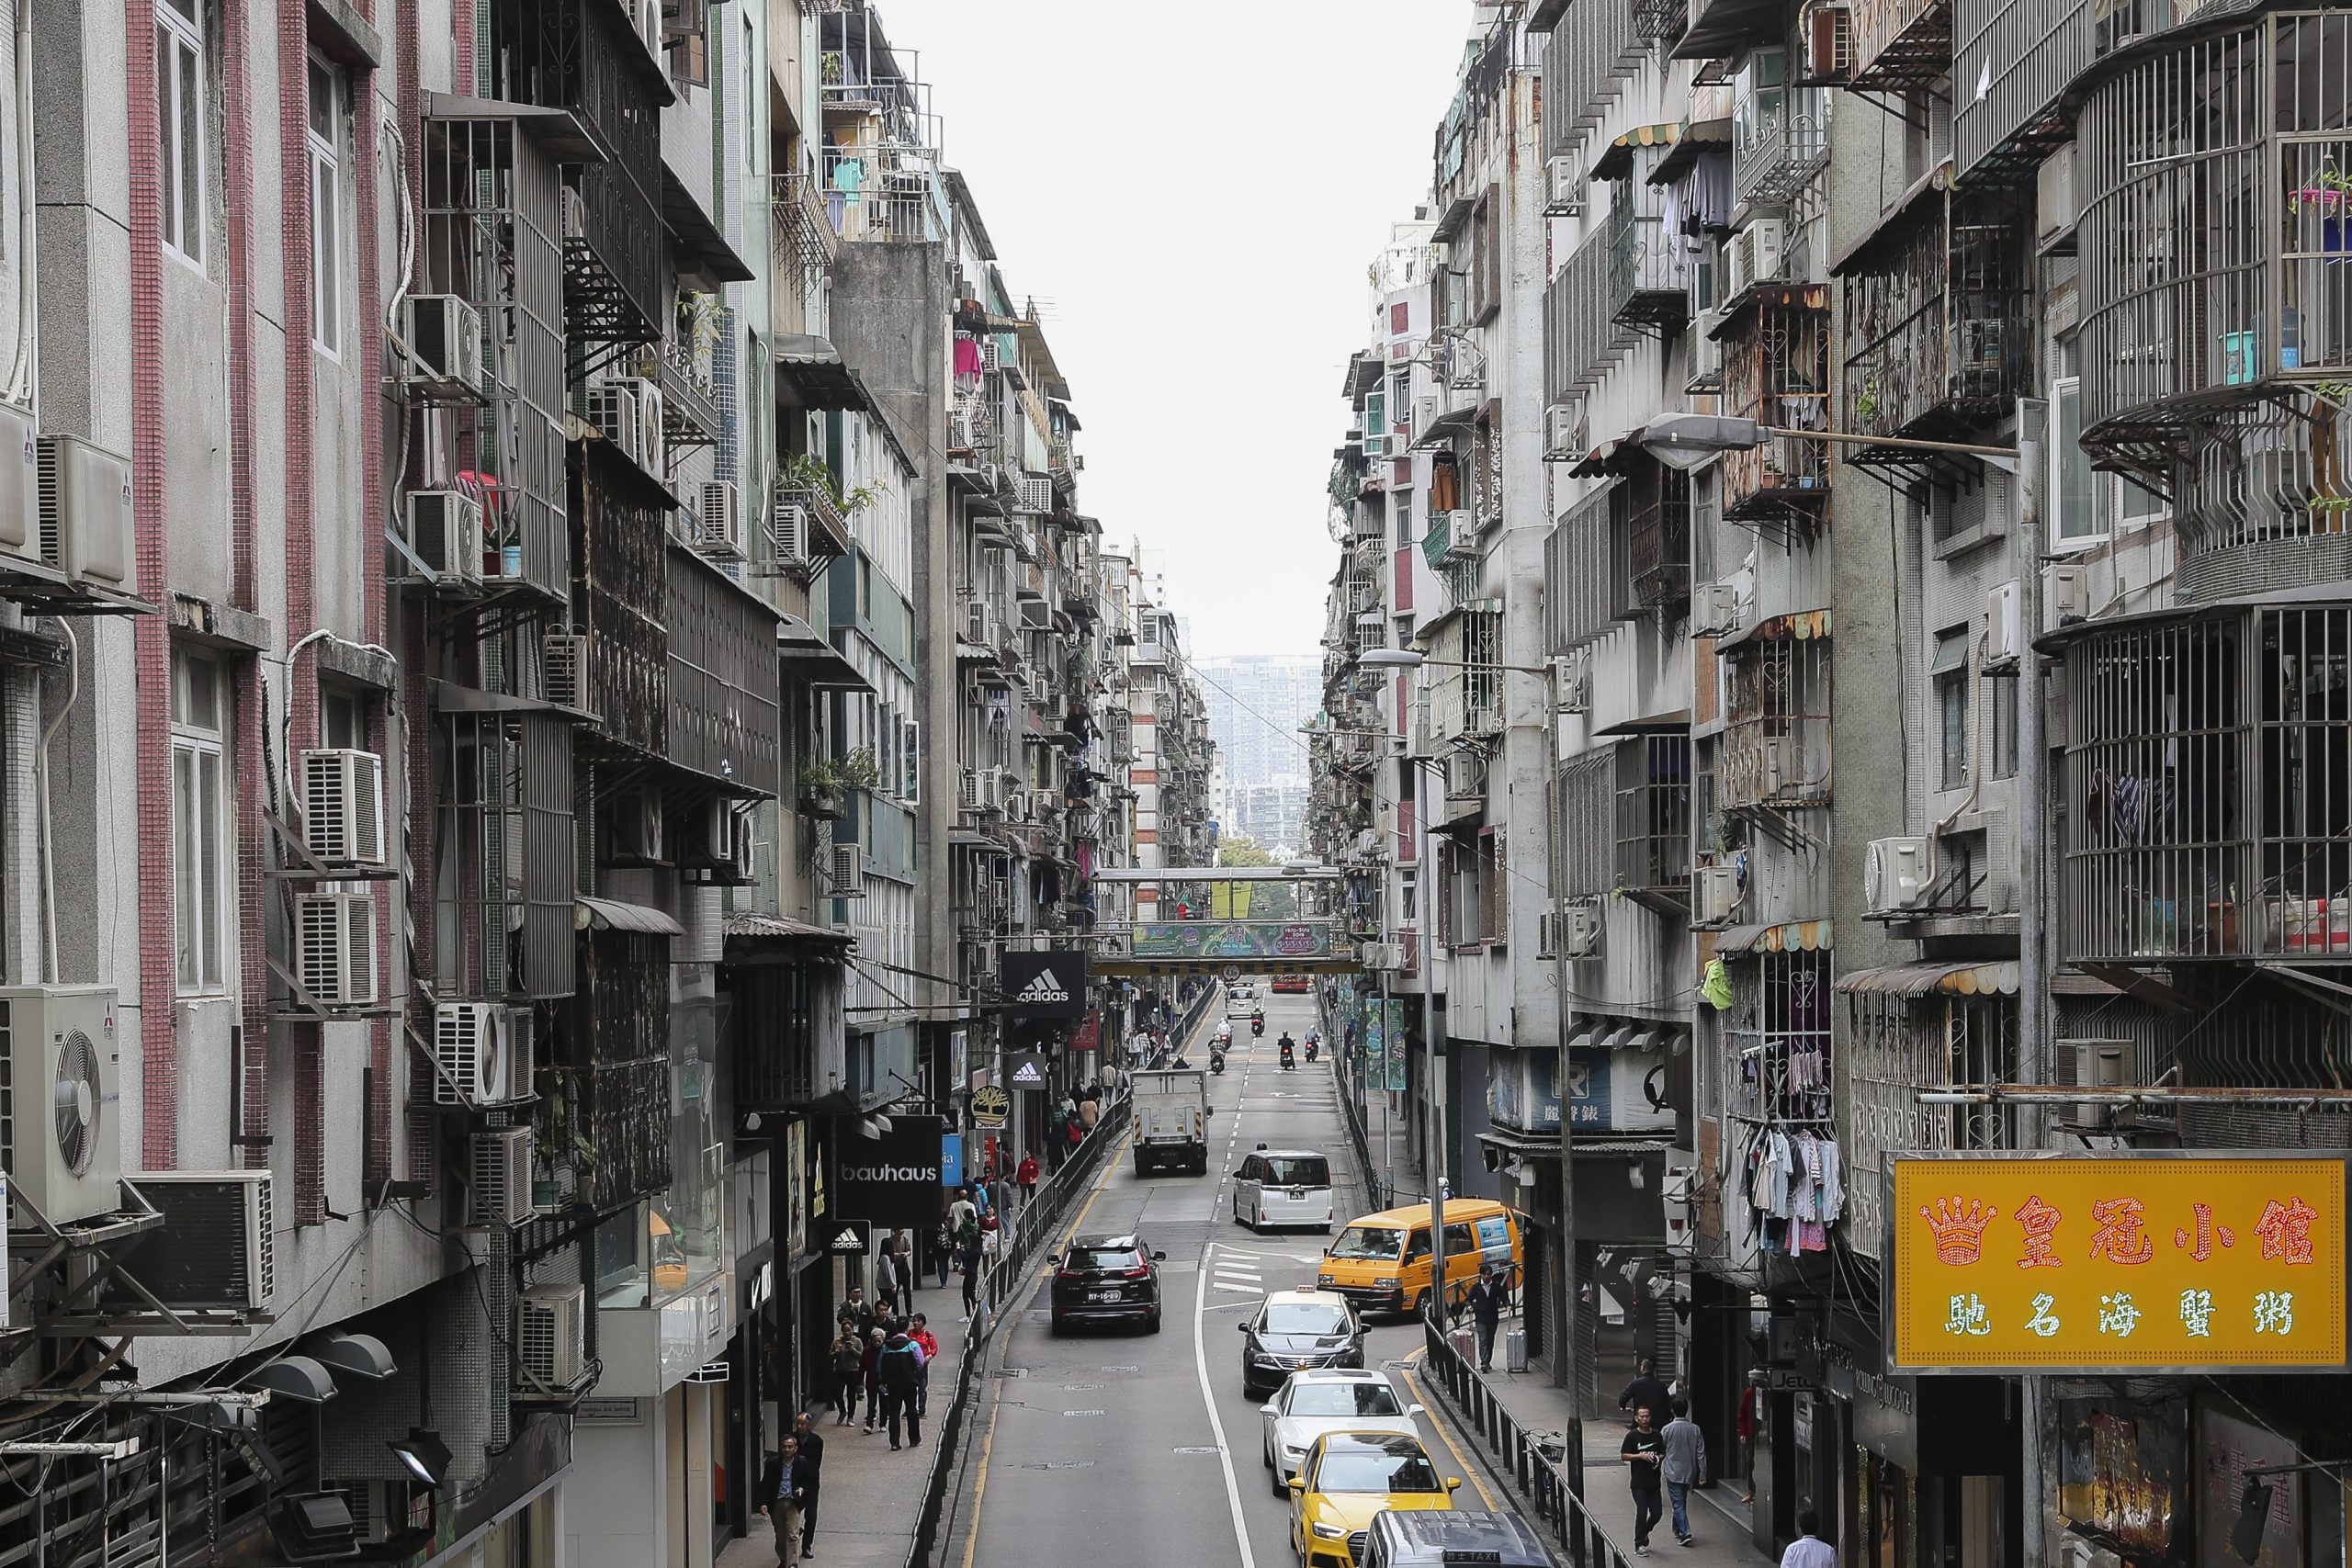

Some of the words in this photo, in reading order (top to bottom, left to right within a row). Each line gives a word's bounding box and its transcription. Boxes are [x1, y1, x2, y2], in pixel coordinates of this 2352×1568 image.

[1018, 989, 1069, 1002] adidas
[842, 1163, 937, 1181] bauhaus
[2014, 1195, 2319, 1269] 皇冠小館
[831, 1241, 863, 1249] adidas
[1944, 1288, 2295, 1337] 馳名海蟹粥
[1470, 1552, 1497, 1561] TAXI
